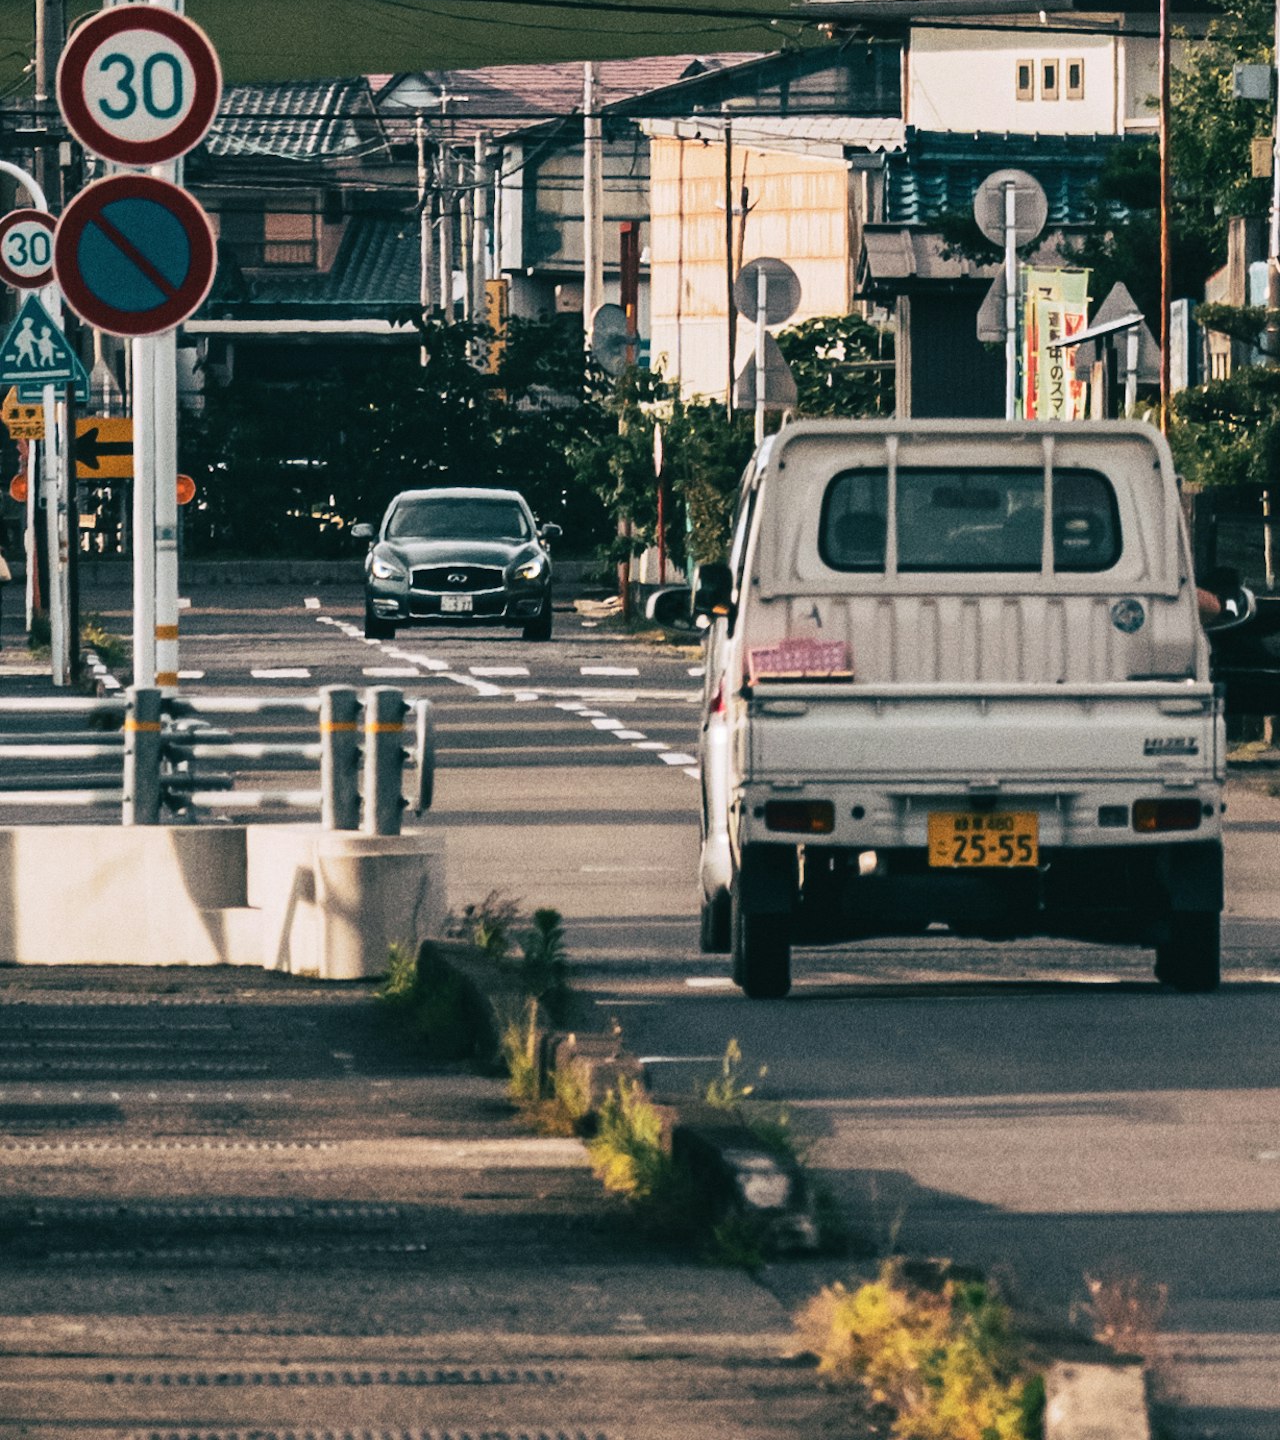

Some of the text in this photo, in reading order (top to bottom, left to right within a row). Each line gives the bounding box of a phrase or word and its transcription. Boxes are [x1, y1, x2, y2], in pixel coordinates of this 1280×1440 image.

[98, 52, 183, 120] 30
[8, 231, 51, 266] 30
[953, 834, 1032, 863] 25-55
